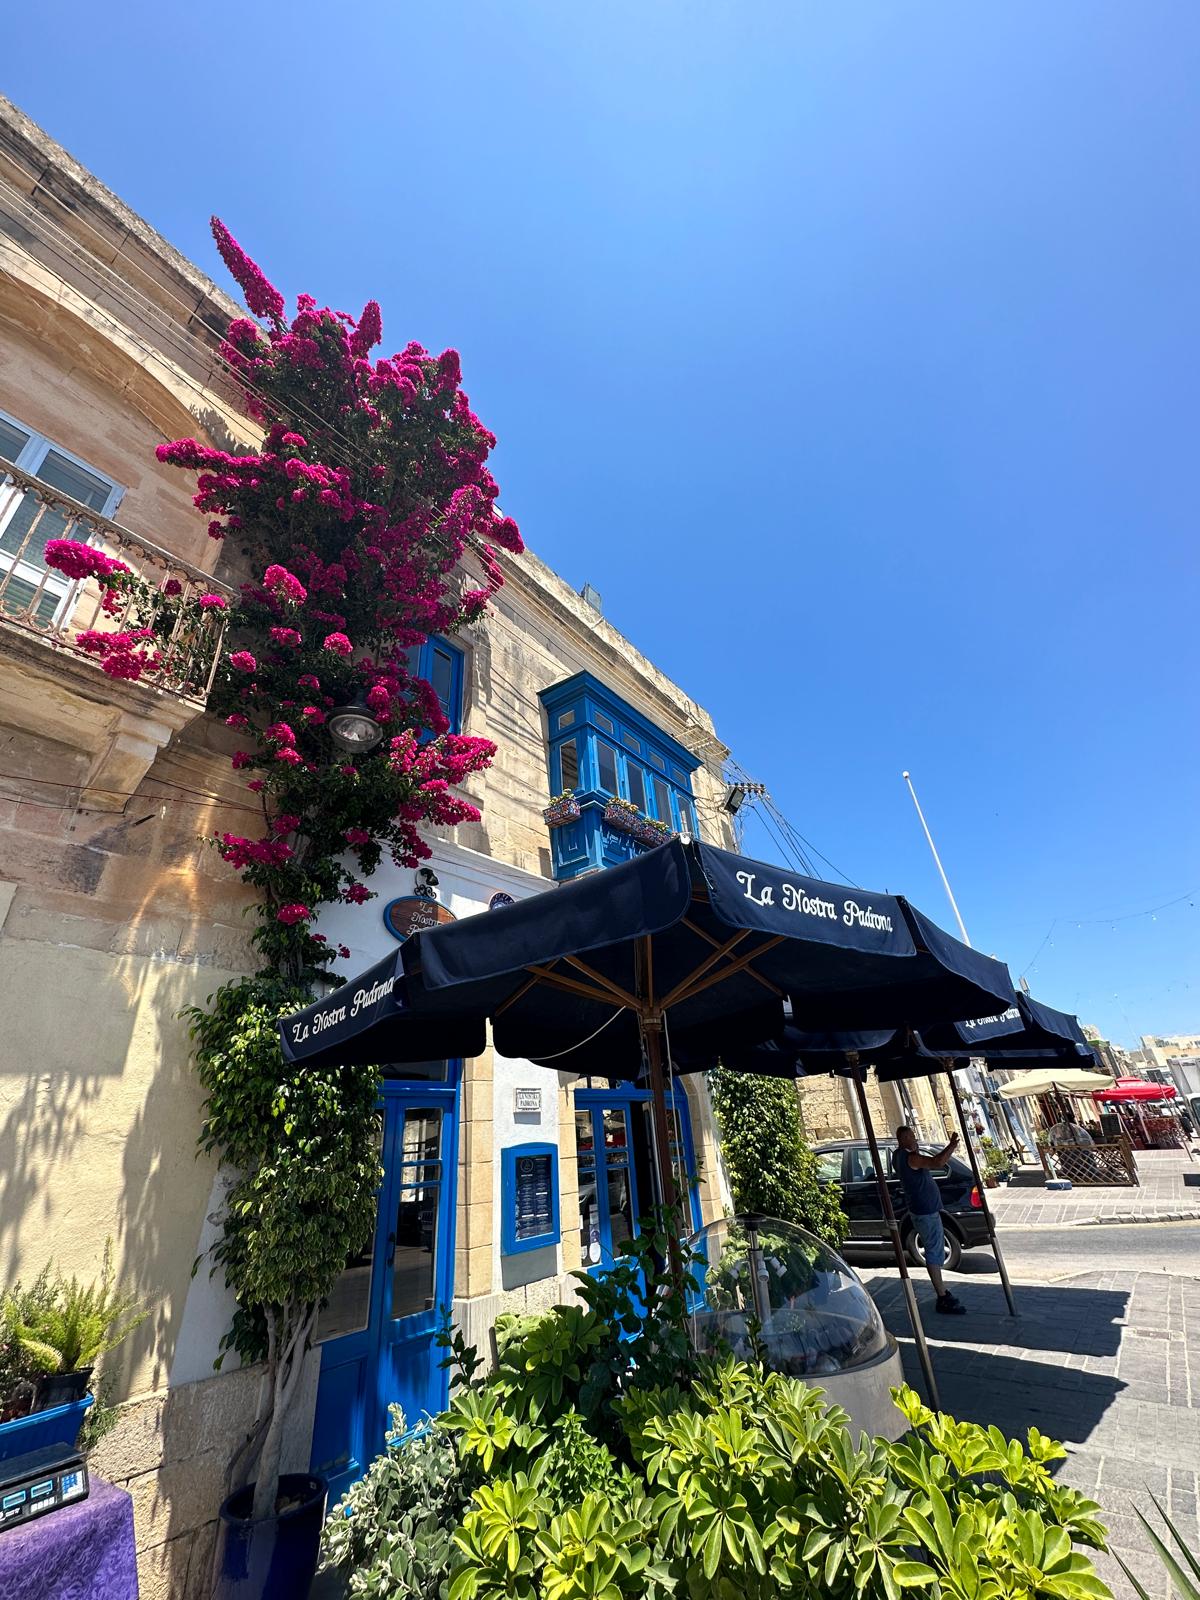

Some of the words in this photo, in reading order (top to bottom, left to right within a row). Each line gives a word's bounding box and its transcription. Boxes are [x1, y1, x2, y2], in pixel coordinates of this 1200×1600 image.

[419, 901, 434, 914] La
[735, 870, 775, 907] La
[782, 883, 838, 920] Nostra
[842, 900, 893, 932] Padrona
[292, 1021, 310, 1043] La
[312, 1004, 346, 1035] Nostra
[350, 976, 394, 1017] Padrona
